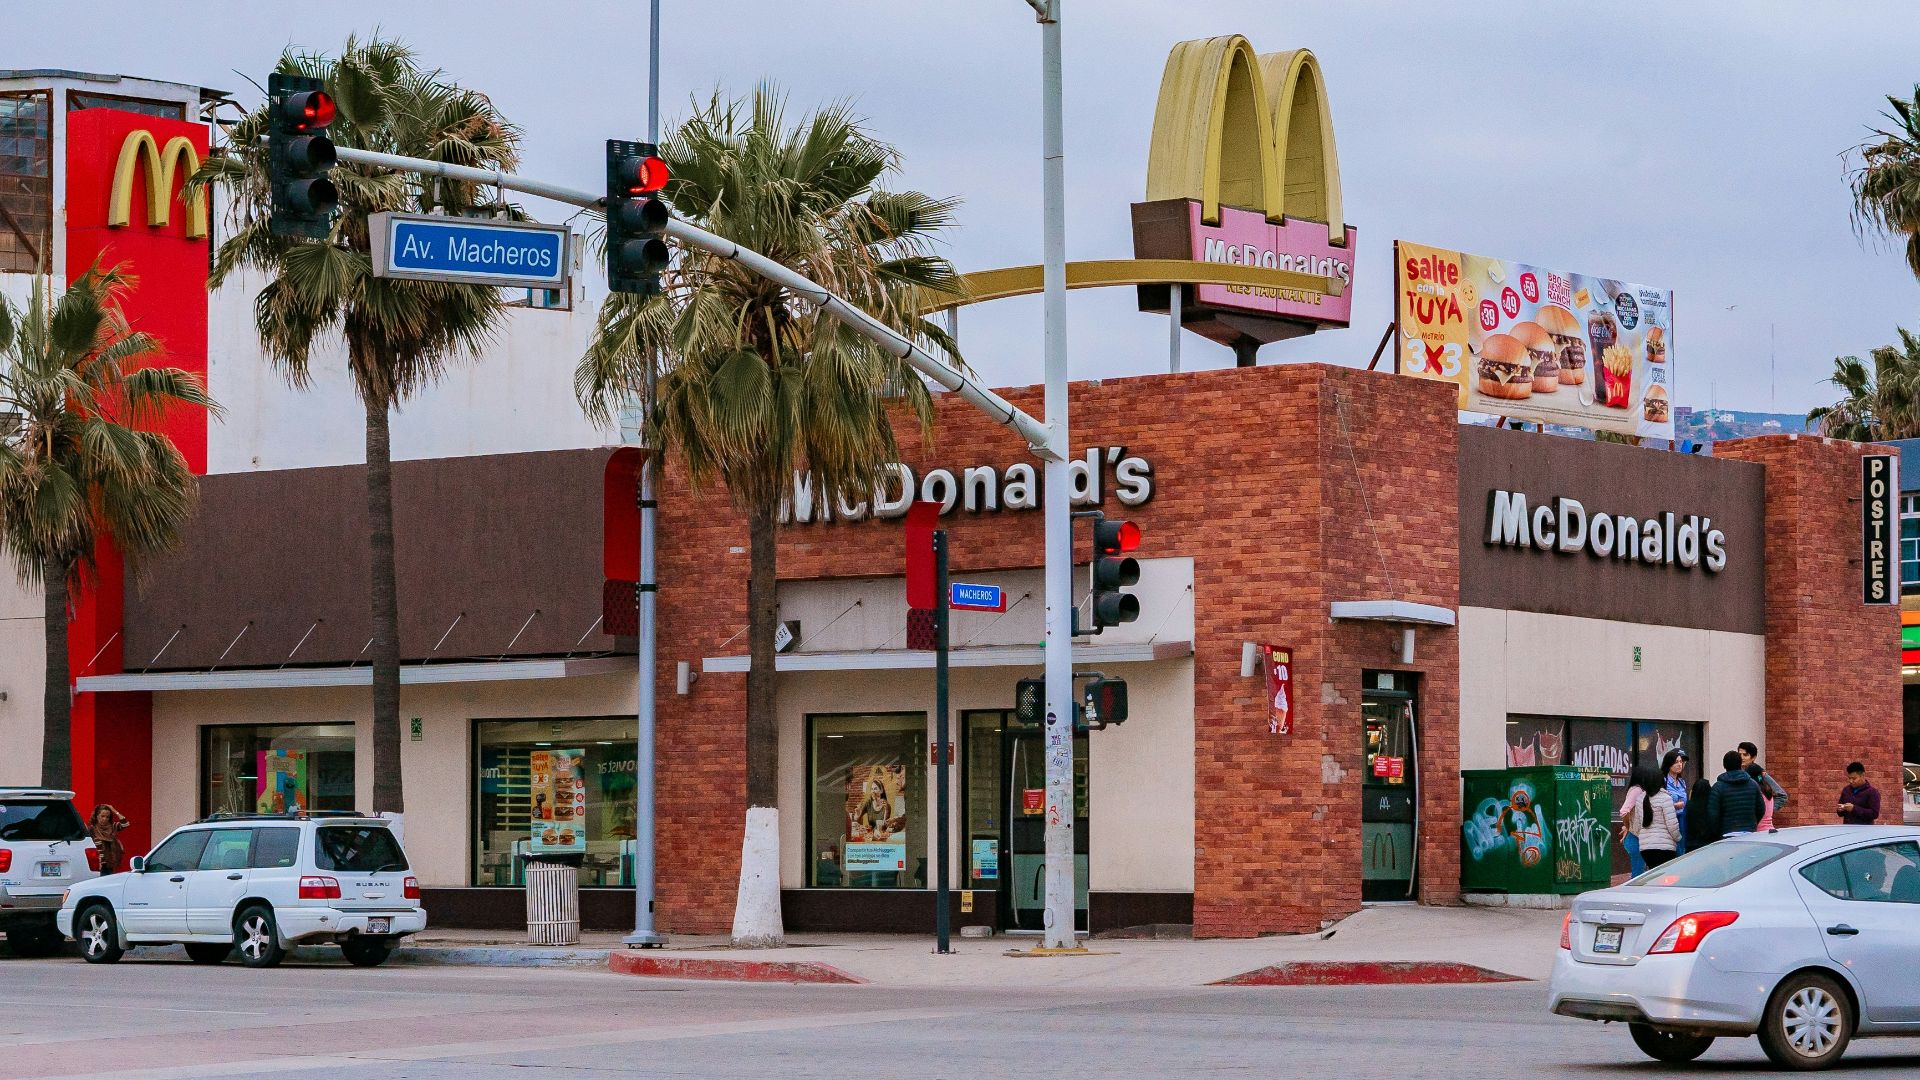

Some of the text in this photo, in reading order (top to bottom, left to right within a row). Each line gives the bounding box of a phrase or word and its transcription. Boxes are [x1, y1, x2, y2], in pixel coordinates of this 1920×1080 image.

[402, 233, 551, 268] Av. Macheros
[1204, 237, 1350, 288] McDonald's
[1406, 254, 1459, 286] salte
[1523, 280, 1536, 298] $59
[1547, 290, 1571, 306] RANCH
[1406, 291, 1463, 325] TUYA
[1481, 307, 1495, 326] $39
[1503, 295, 1517, 314] $49
[778, 447, 1152, 522] McDonad's
[1489, 490, 1727, 573] McDonald's
[1870, 460, 1885, 599] POSTRES
[959, 588, 992, 602] MACHEROS
[1272, 651, 1289, 664] CONO
[1574, 745, 1629, 774] MALTEADAS
